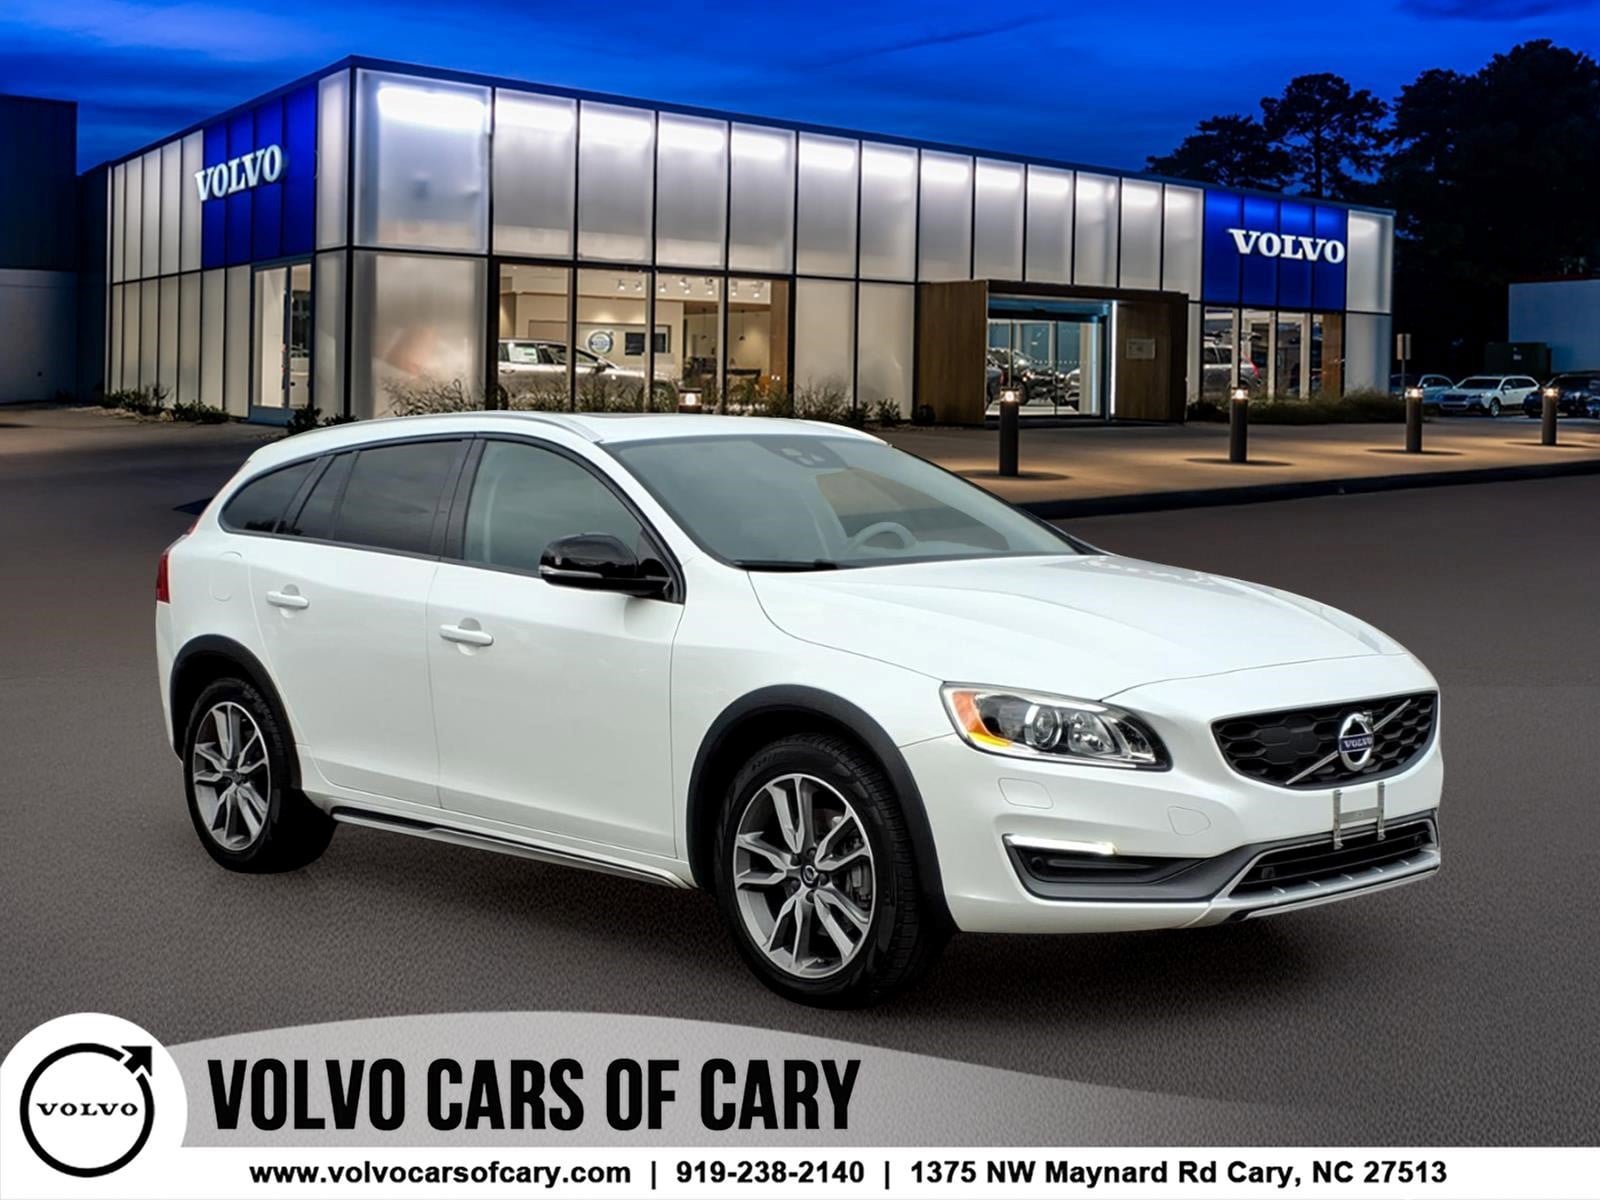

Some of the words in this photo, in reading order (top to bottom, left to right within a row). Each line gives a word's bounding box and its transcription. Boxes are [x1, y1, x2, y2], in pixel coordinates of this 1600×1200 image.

[194, 144, 282, 201] VOLVO
[1227, 228, 1345, 263] VOLVO
[1343, 737, 1373, 748] VOLVO
